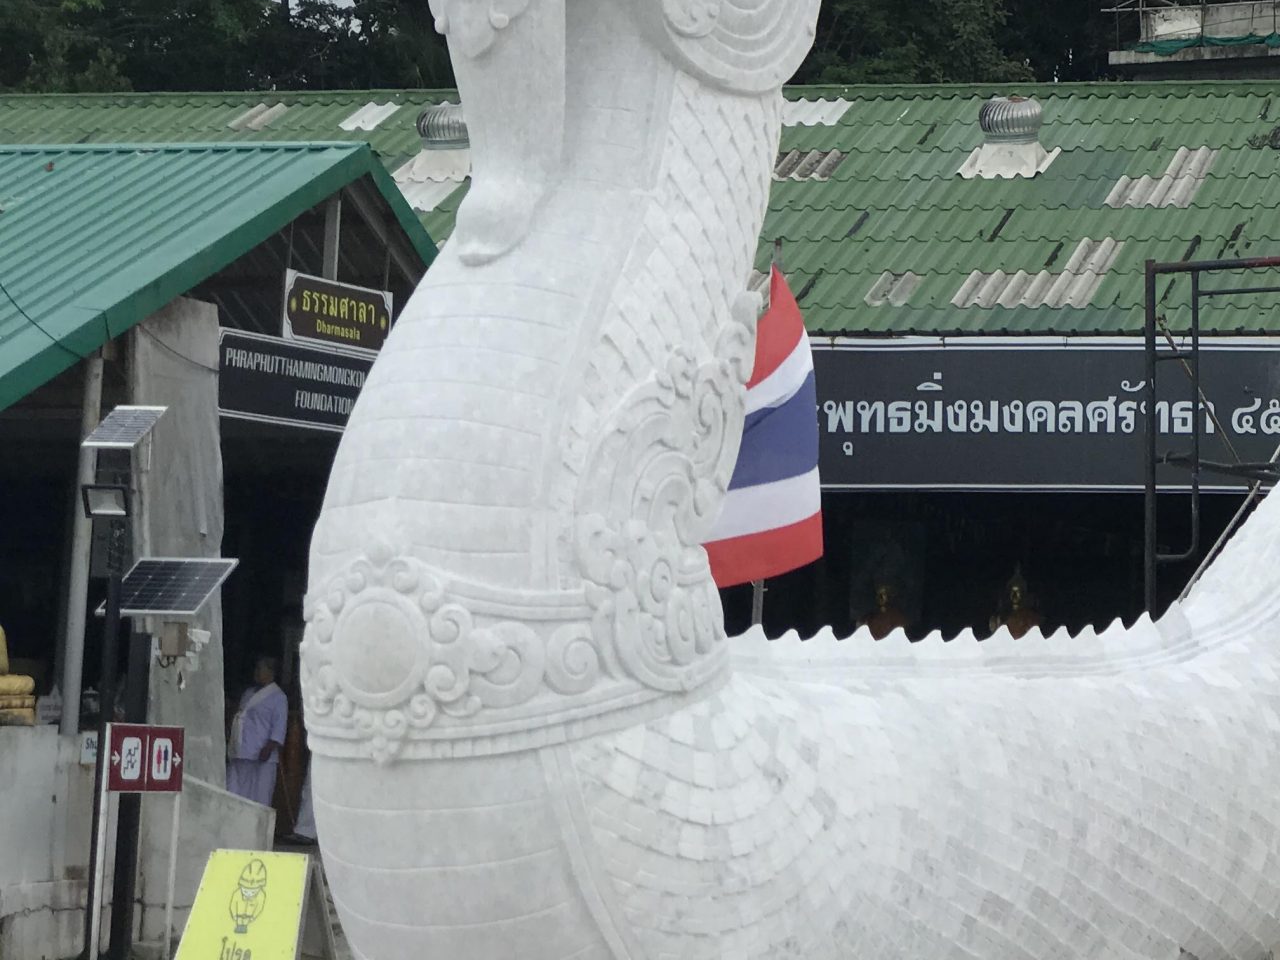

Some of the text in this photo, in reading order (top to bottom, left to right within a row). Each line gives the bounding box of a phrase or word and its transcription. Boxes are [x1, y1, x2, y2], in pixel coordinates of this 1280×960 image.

[303, 290, 375, 325] ธรรมศาลา
[316, 319, 360, 340] Dharmasala
[816, 372, 1215, 456] พุทธมิ่งมงคลศรัทธา
